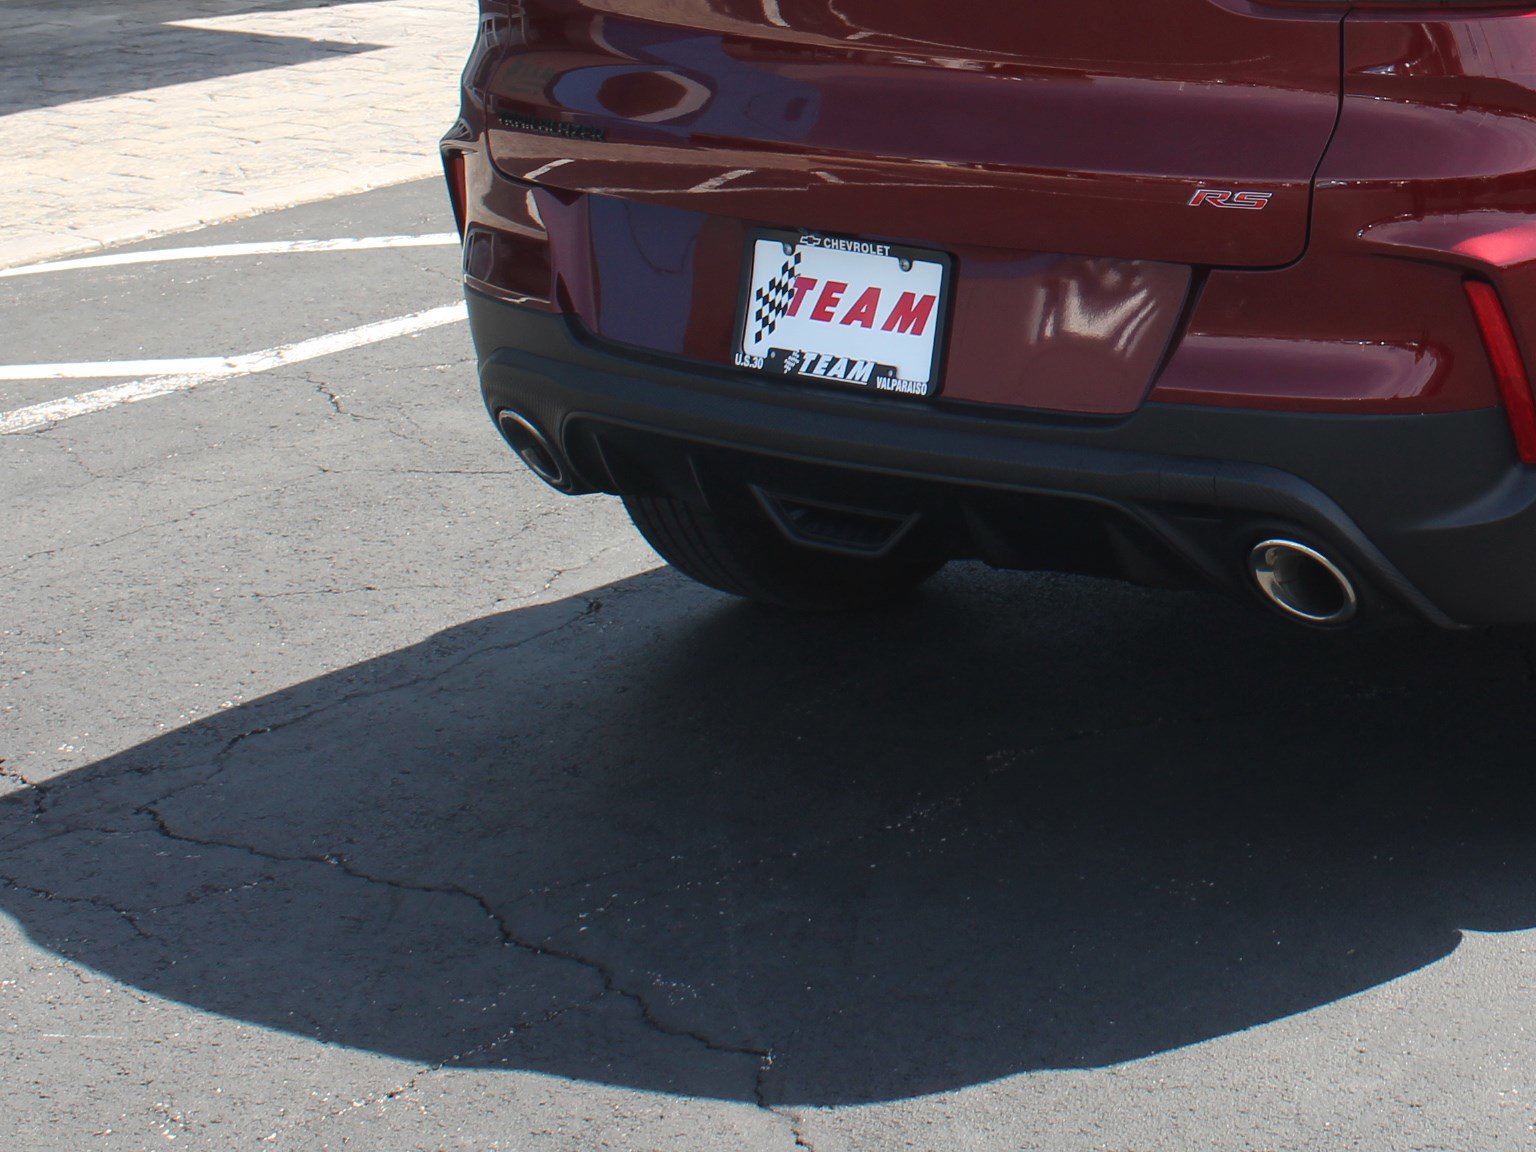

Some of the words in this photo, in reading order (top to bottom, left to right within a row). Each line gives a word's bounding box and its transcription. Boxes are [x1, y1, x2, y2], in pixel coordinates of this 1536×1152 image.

[1188, 189, 1273, 210] RS
[823, 237, 891, 257] CHEVROLET
[786, 276, 936, 336] TEAM
[799, 351, 877, 383] TEAM
[876, 376, 928, 396] VALPARAISO
